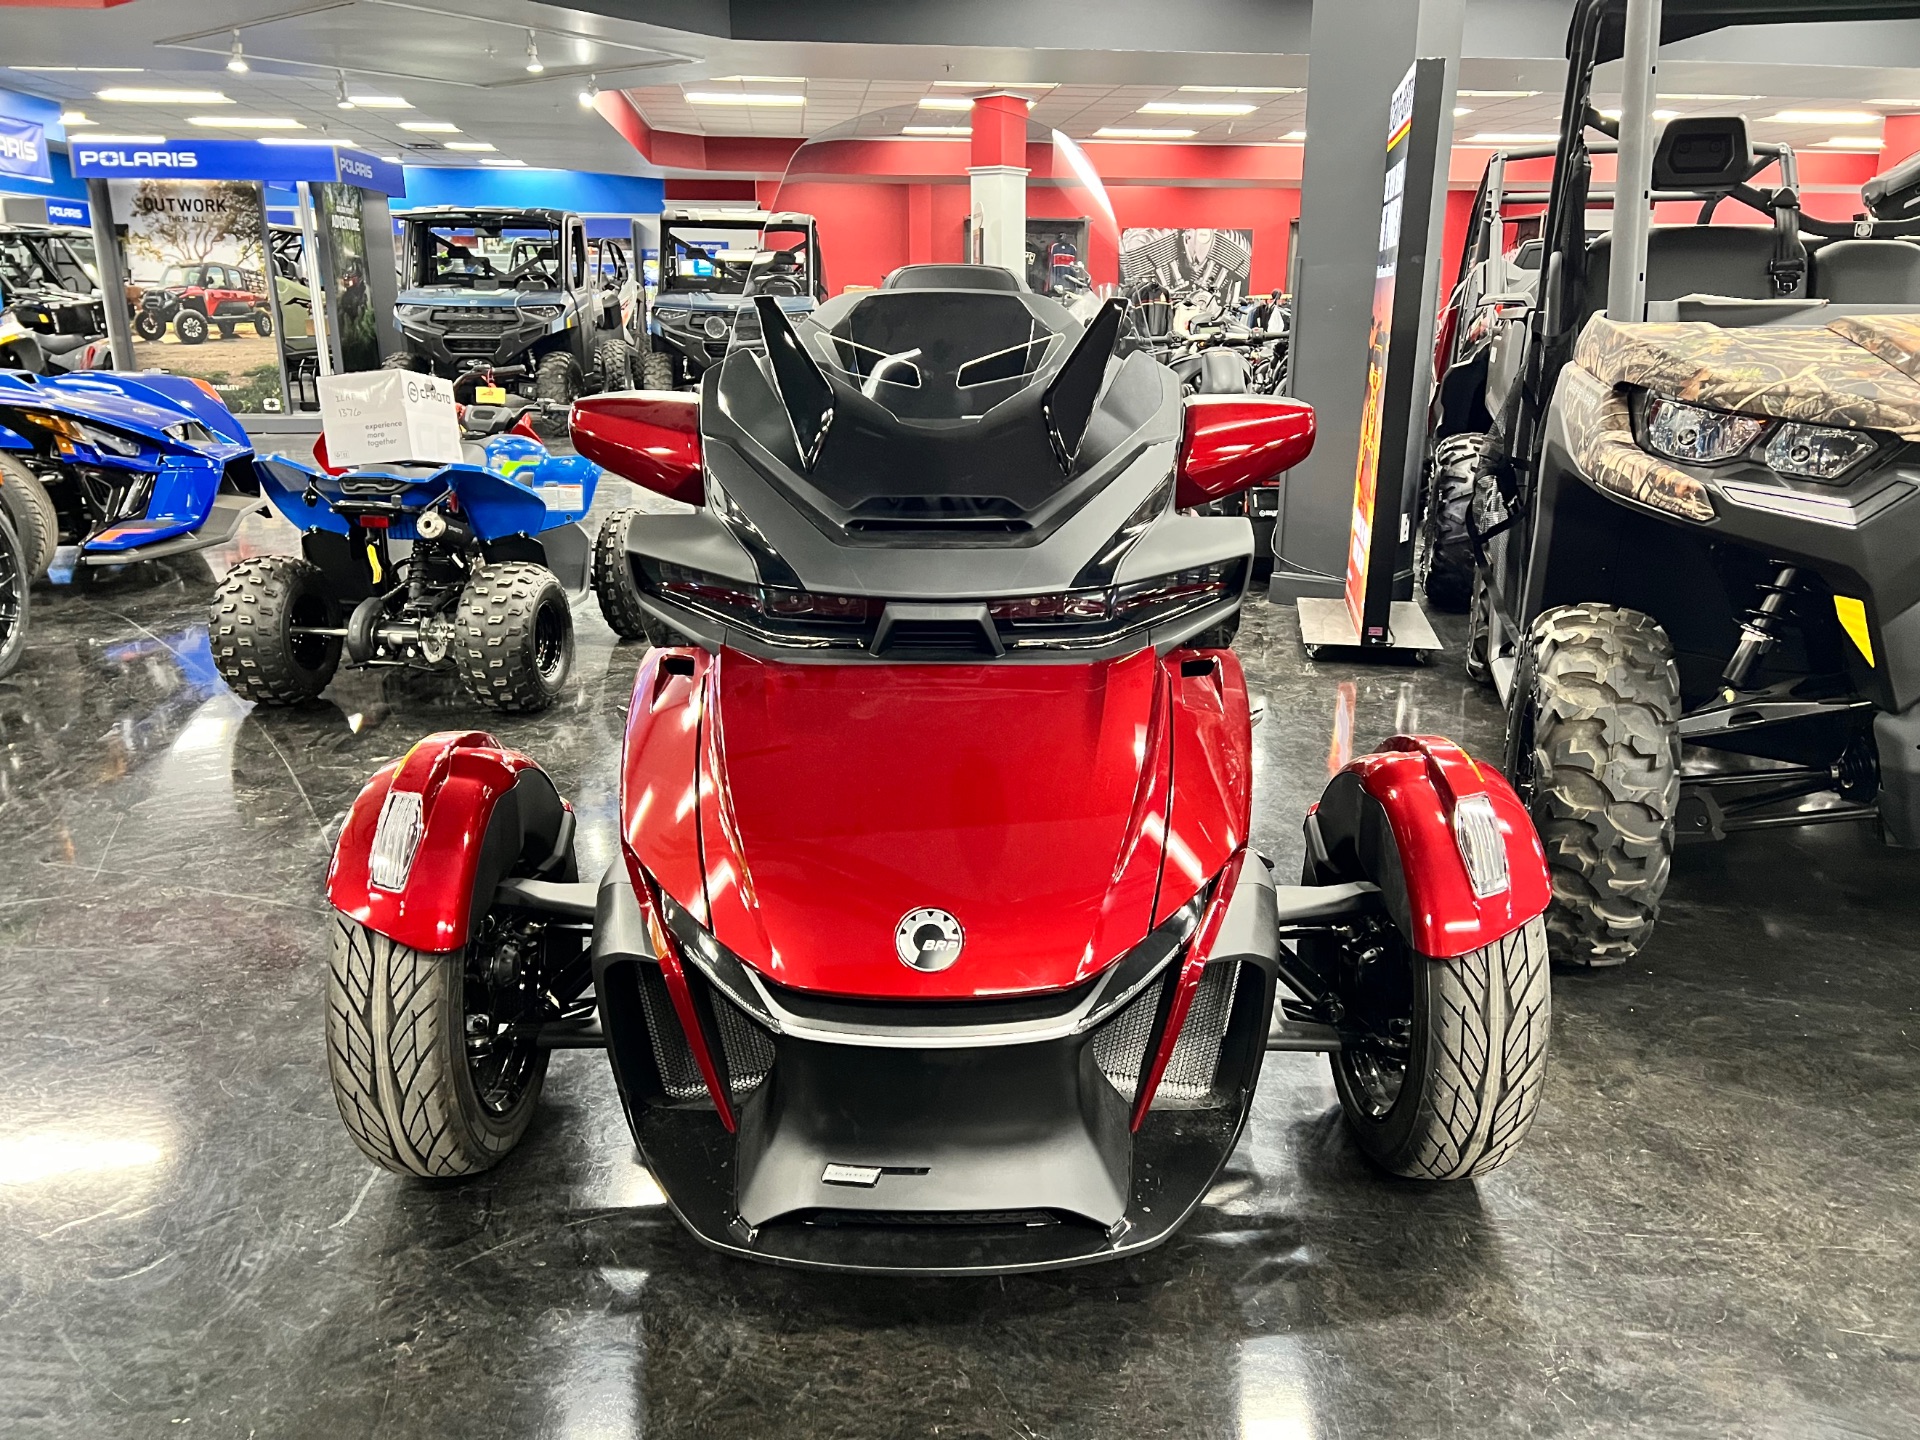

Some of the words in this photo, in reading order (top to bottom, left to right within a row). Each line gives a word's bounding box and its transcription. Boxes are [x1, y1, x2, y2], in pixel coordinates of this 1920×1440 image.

[0, 137, 38, 162] ARIS
[79, 150, 198, 168] POLARIS
[340, 157, 373, 179] POLARIS
[143, 198, 228, 213] OUTWORK
[49, 206, 83, 219] POLARIS
[167, 215, 189, 224] THEM
[191, 215, 206, 224] ALL
[365, 421, 403, 432] experience
[367, 438, 397, 448] together
[921, 939, 959, 952] BRP
